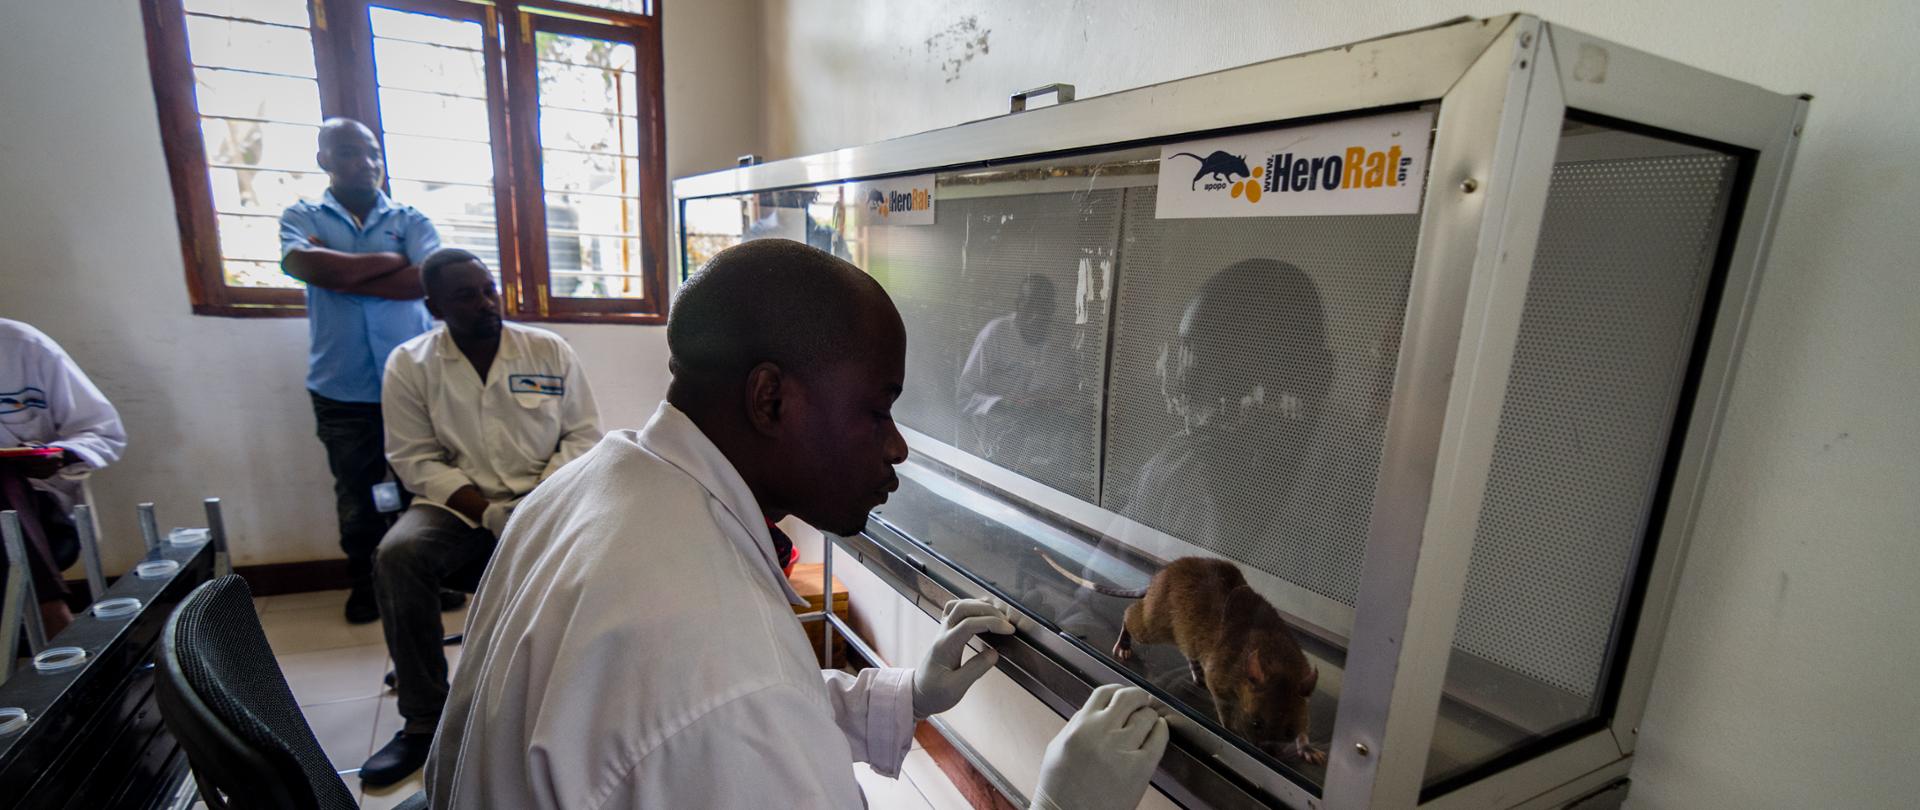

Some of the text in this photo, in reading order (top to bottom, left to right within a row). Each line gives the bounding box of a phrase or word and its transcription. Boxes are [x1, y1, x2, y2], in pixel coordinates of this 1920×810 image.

[1263, 145, 1412, 193] www. HeroRat .org
[1204, 182, 1227, 191] apopo
[890, 188, 929, 212] HeroRat
